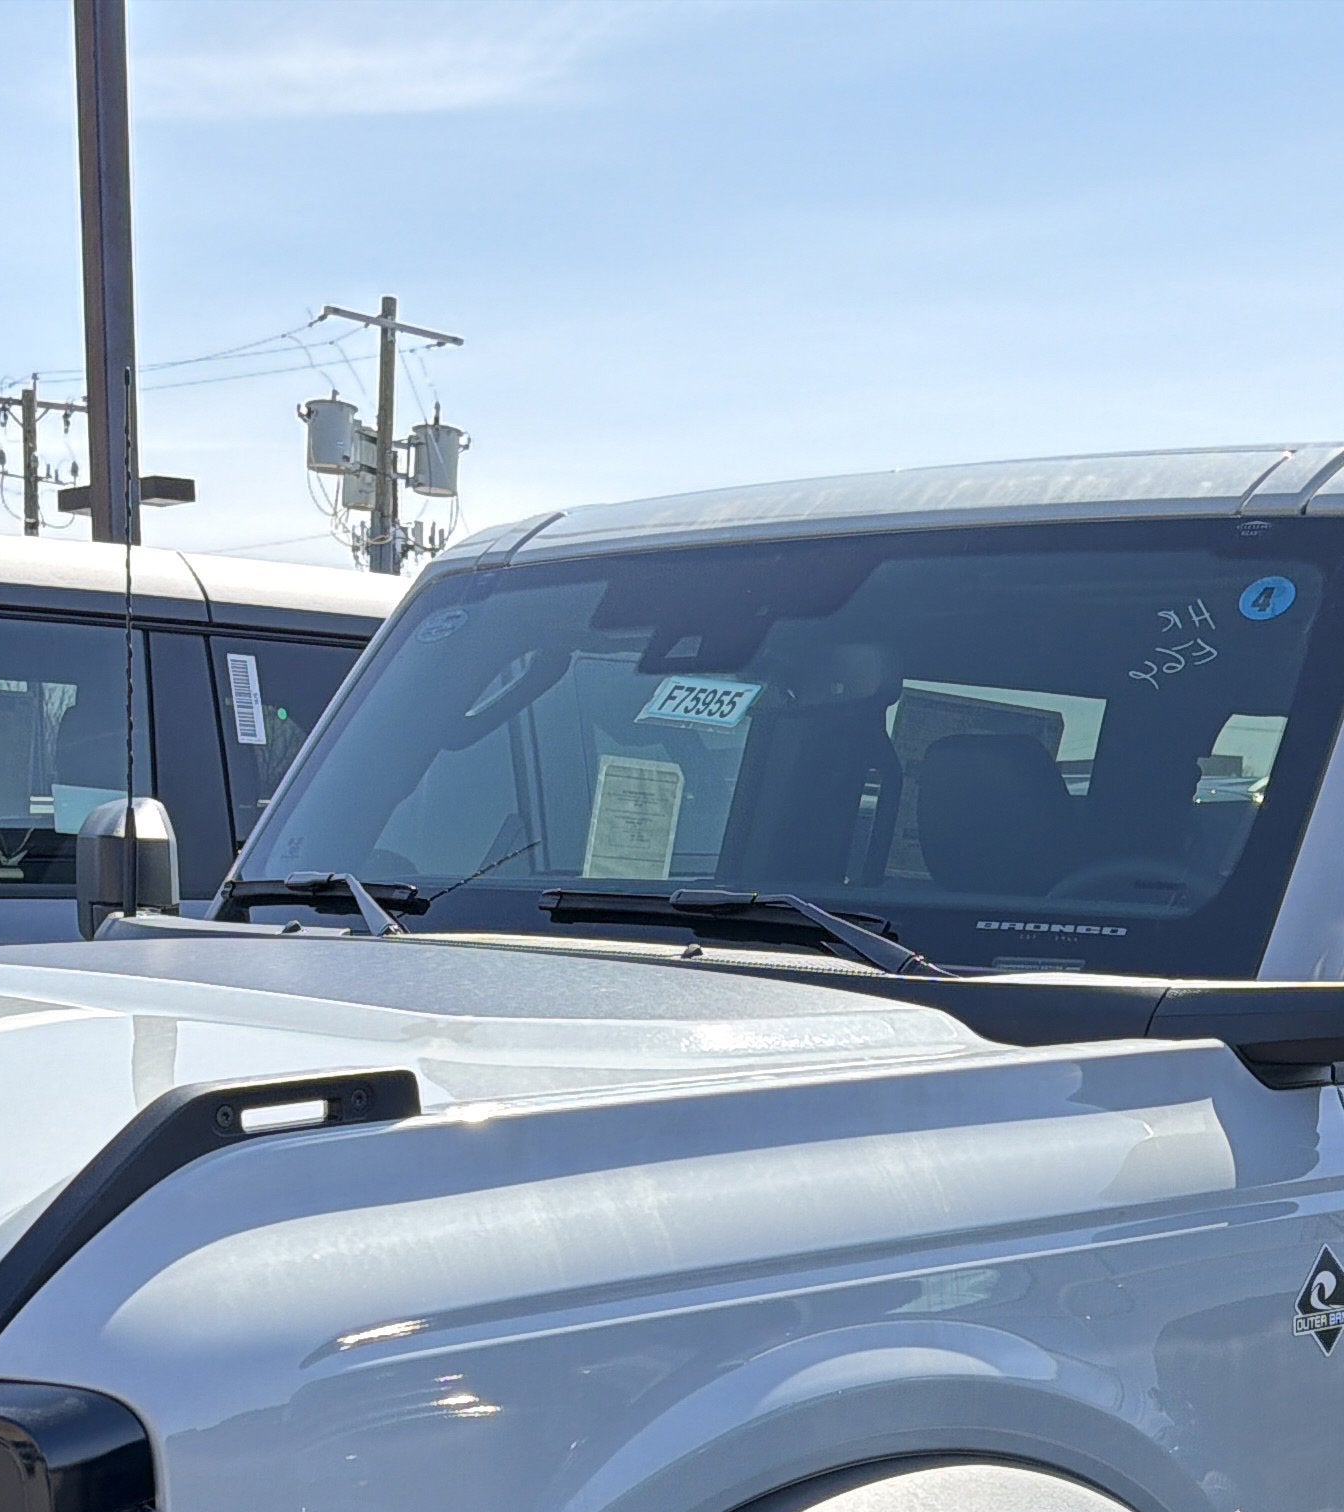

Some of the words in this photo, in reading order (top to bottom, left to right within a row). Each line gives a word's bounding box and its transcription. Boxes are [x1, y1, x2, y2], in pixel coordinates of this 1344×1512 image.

[1251, 587, 1275, 612] 4
[658, 685, 744, 718] F75955
[976, 921, 1127, 936] BRONCO
[1297, 1314, 1327, 1330] OUTER
